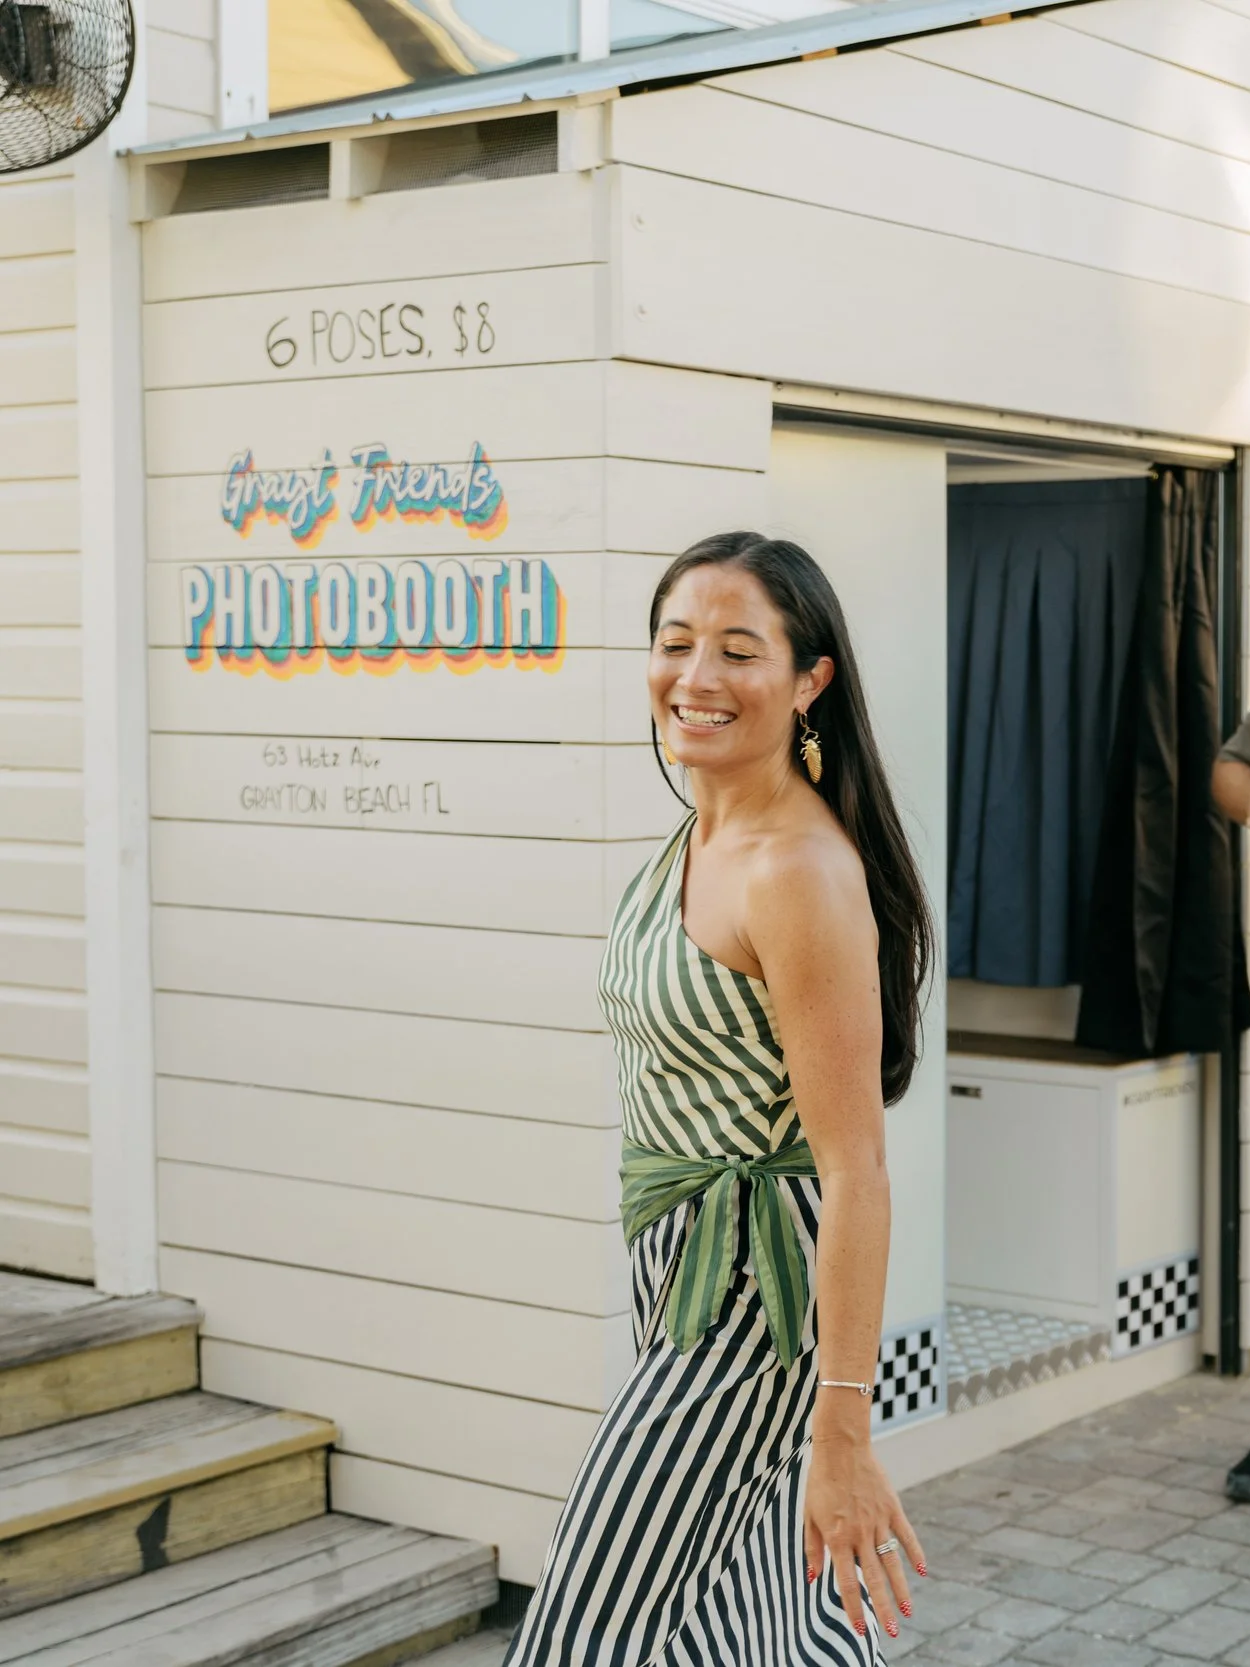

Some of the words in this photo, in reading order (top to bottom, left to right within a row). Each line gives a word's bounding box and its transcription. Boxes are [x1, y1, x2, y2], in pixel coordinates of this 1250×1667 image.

[265, 316, 298, 369] 6
[311, 302, 433, 366] POSES,
[452, 301, 497, 358] $8
[349, 441, 508, 538] Friends
[180, 558, 565, 675] PHOTOBOOTH
[262, 743, 289, 768] 63
[239, 783, 327, 814] GRAYTON
[343, 783, 412, 815] BEACH
[422, 781, 450, 815] FL
